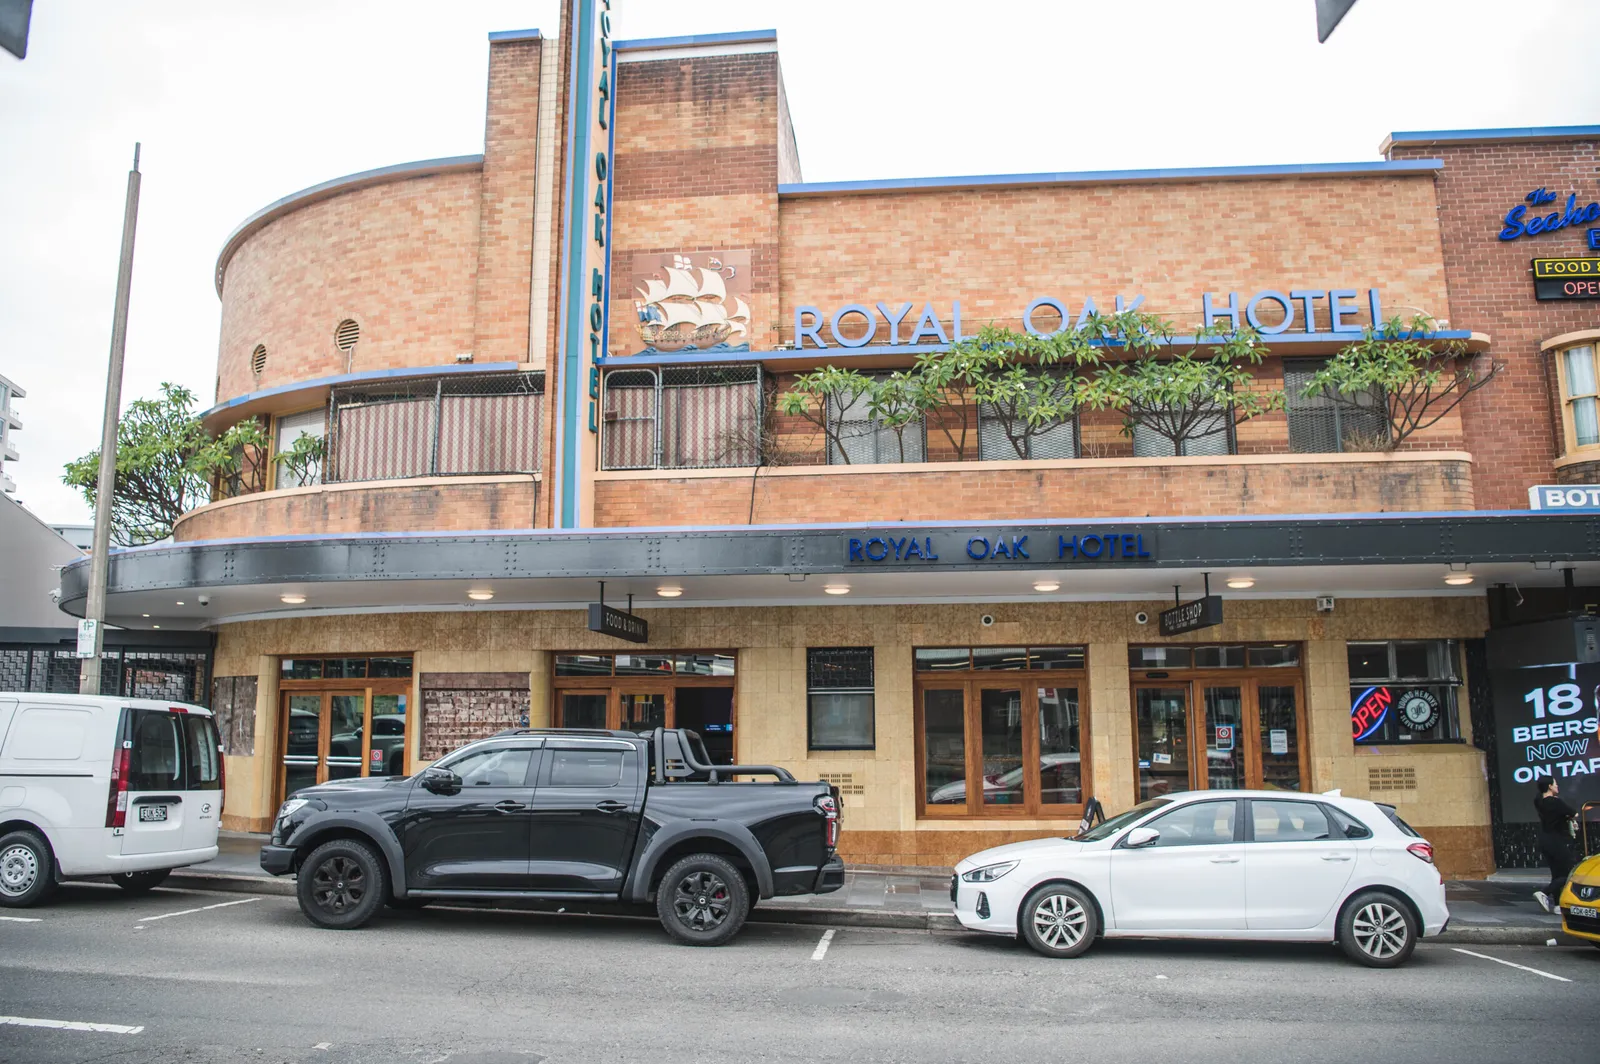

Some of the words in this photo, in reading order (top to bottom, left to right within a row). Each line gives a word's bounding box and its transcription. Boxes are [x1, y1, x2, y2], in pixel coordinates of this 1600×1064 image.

[595, 152, 607, 247] OAK
[1525, 187, 1557, 207] The
[1544, 261, 1591, 273] FOOD
[1563, 281, 1600, 295] OPE
[794, 300, 978, 350] ROYAL
[1022, 293, 1148, 340] OAK
[1203, 288, 1386, 334] HOTEL
[588, 267, 603, 433] HOTEL
[1545, 489, 1600, 507] BOT
[849, 536, 939, 561] ROYAL
[966, 535, 1030, 560] OAK
[1058, 533, 1150, 559] HOTEL
[605, 612, 622, 629] FOOD
[1165, 608, 1185, 626] BOTTLE
[1186, 602, 1203, 620] SHOP
[1398, 690, 1414, 709] YOUNG
[1415, 689, 1438, 708] HENRYS
[1524, 683, 1584, 719] 18
[1351, 686, 1393, 739] OPEN
[1513, 717, 1599, 743] BEERS
[1526, 738, 1590, 762] NOW
[1513, 764, 1553, 783] ON
[1556, 757, 1600, 778] TAP
